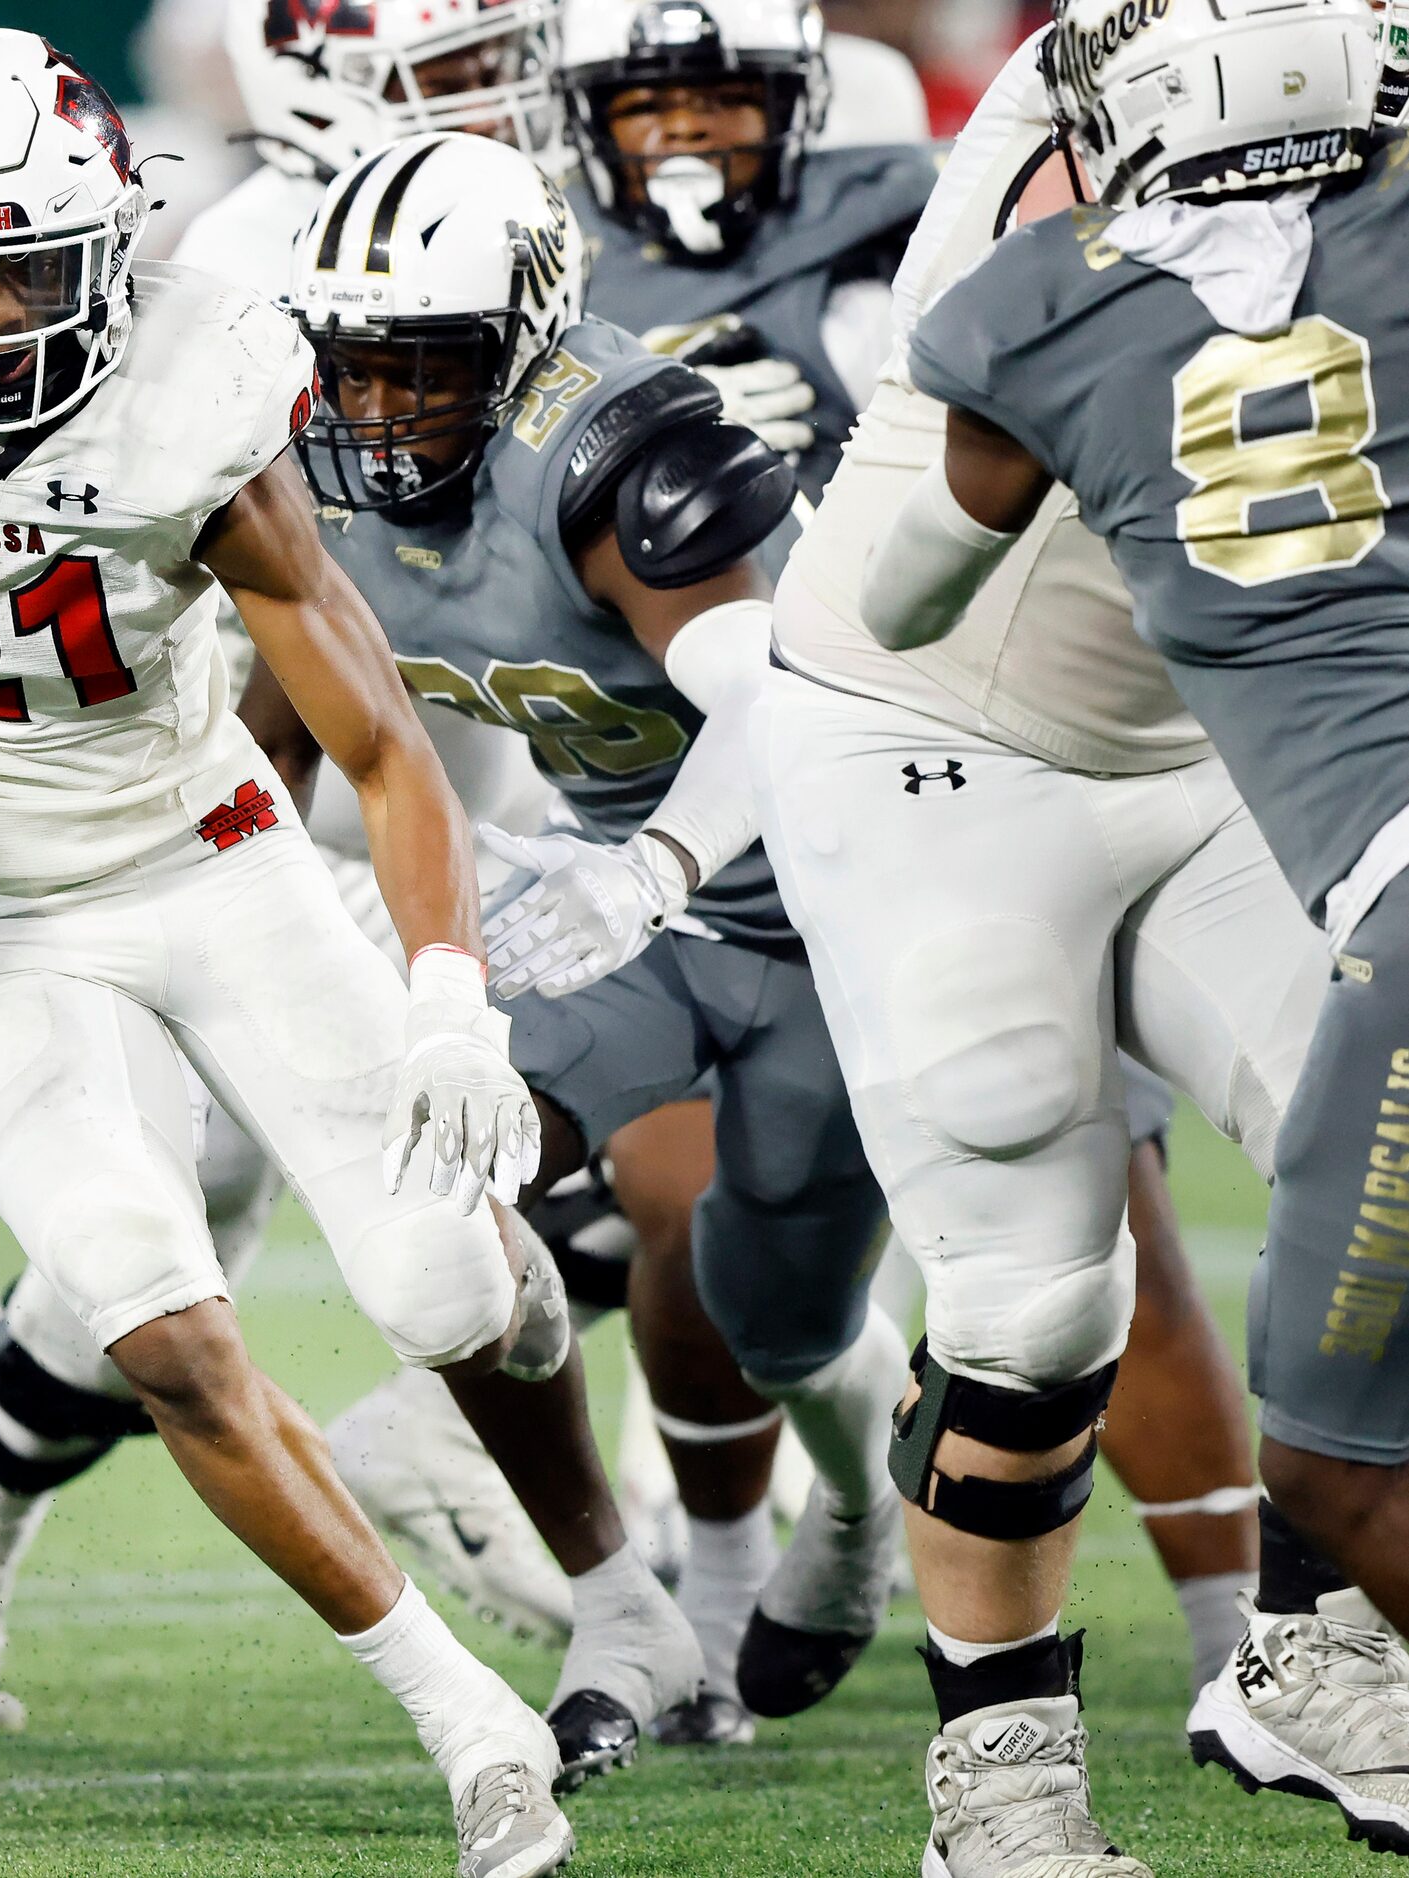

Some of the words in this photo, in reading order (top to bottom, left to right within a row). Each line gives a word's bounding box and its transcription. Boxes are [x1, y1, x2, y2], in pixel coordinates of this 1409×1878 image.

[1243, 132, 1341, 172] schutt
[1172, 314, 1390, 588] 8
[998, 1721, 1030, 1762] FORCE
